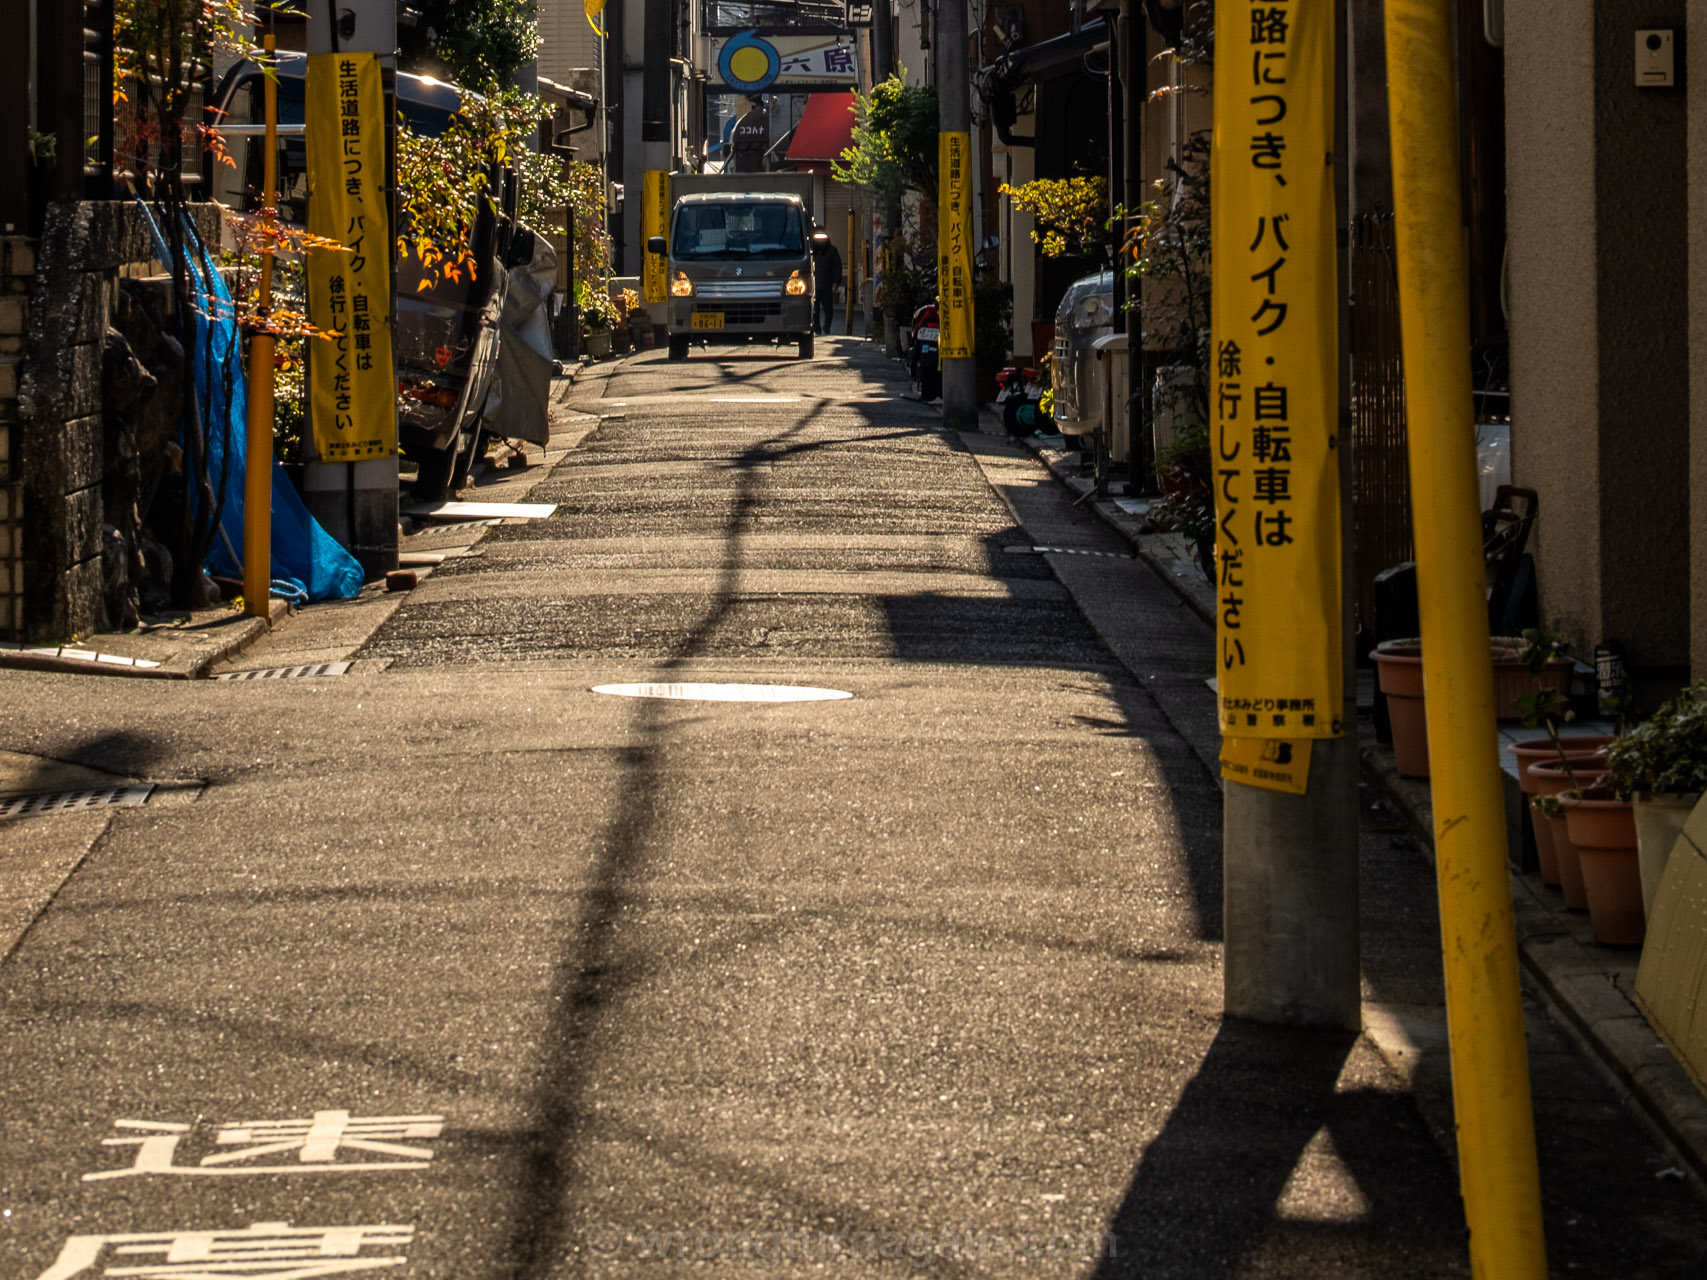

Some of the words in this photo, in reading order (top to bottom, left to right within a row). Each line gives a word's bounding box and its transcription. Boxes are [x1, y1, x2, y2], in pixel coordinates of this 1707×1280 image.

[782, 45, 855, 73] 六原
[339, 60, 373, 371] 生活道路につき、バイク・自転車は
[329, 275, 353, 430] 徐行してください
[1217, 340, 1245, 669] 徐行してください
